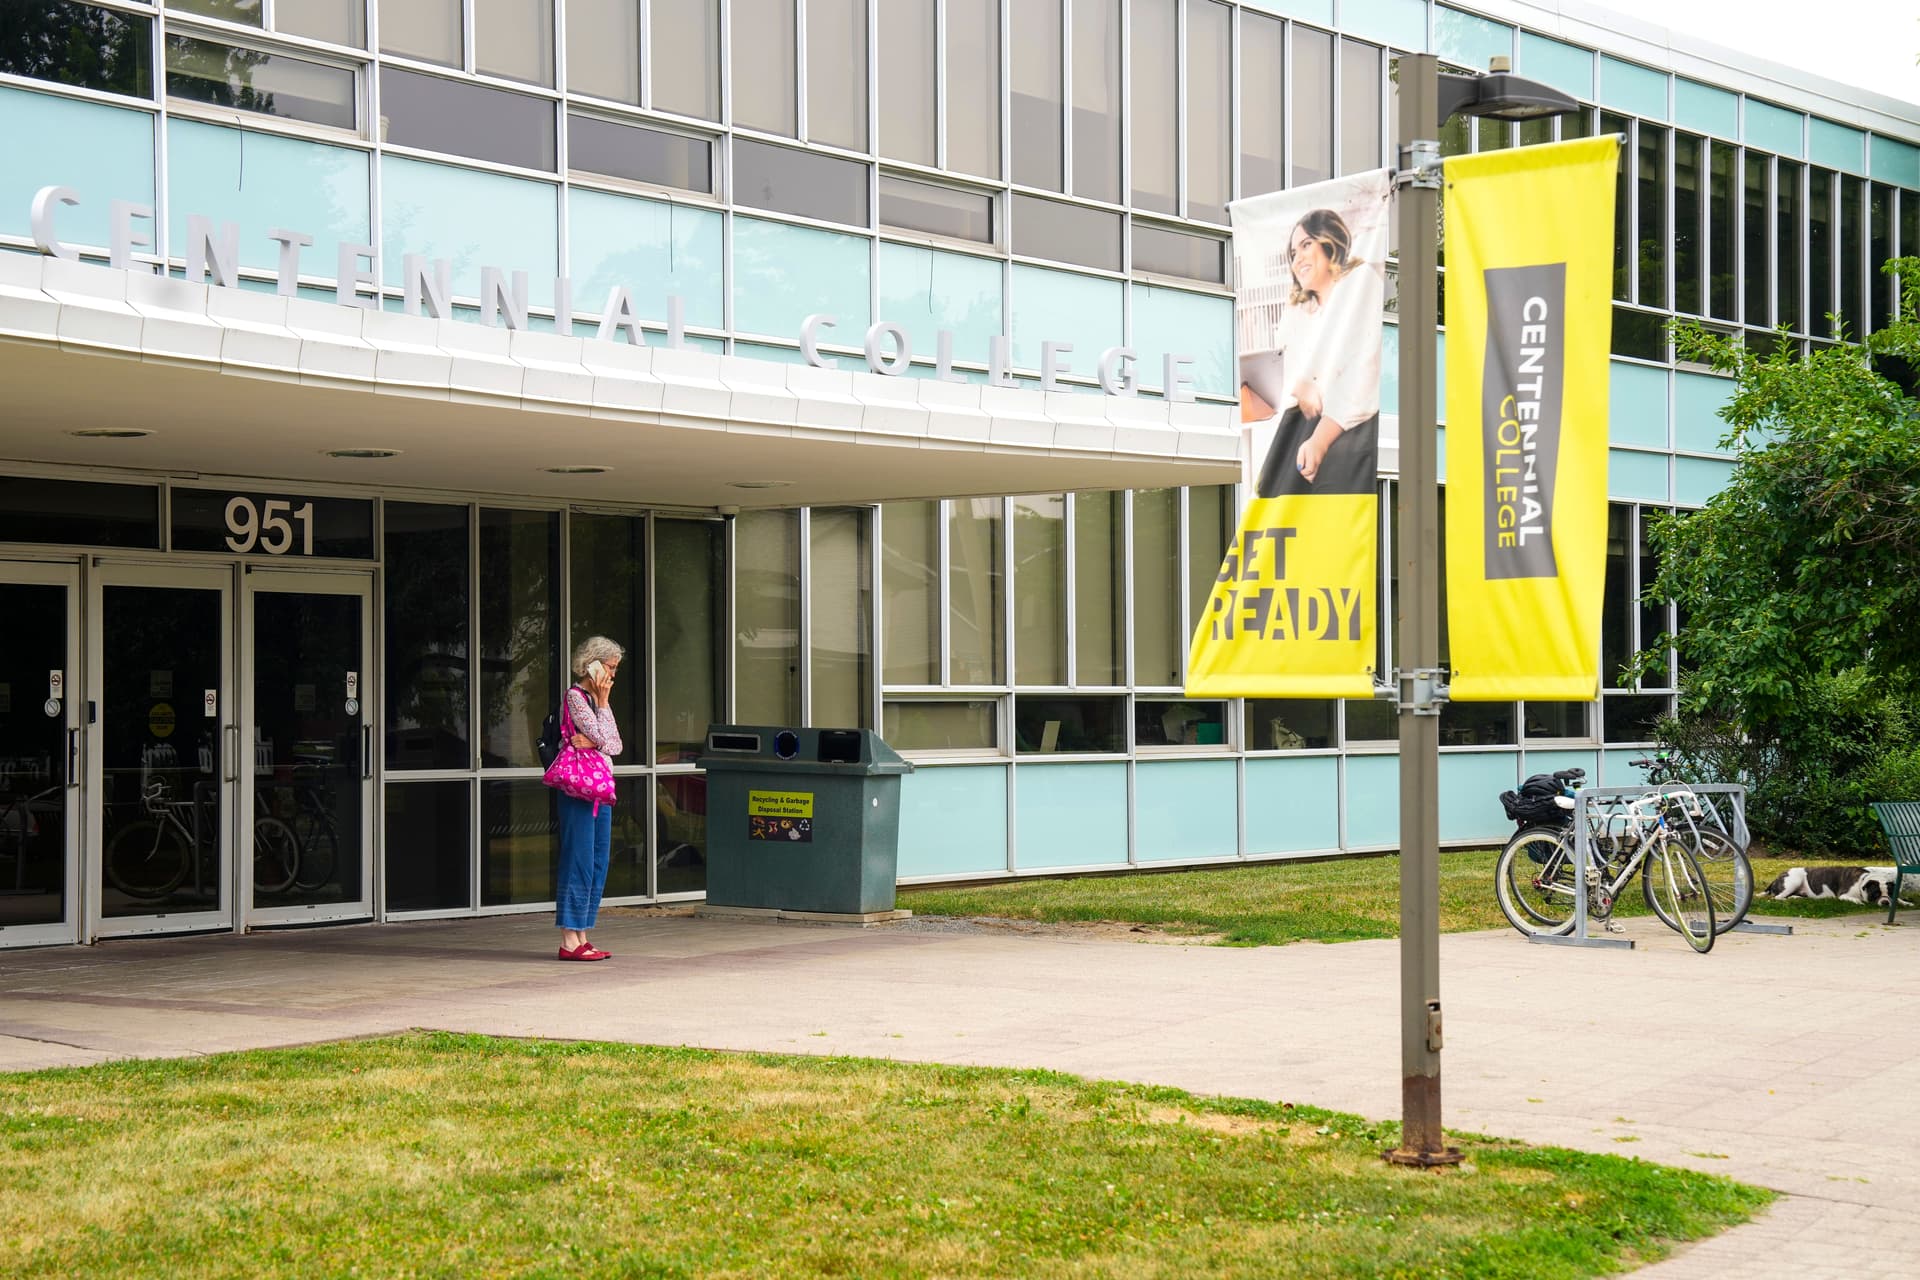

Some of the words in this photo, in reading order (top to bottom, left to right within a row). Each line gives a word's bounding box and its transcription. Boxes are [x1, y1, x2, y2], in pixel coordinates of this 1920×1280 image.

[31, 186, 702, 352] CENTENNIAL
[799, 314, 1197, 403] COLLEGE
[1496, 394, 1521, 549] COLLEGE
[1516, 296, 1548, 547] CENTENNIAL
[224, 496, 314, 555] 951
[1206, 587, 1361, 641] READY
[752, 796, 778, 804] Recycling
[786, 797, 810, 805] Garbage
